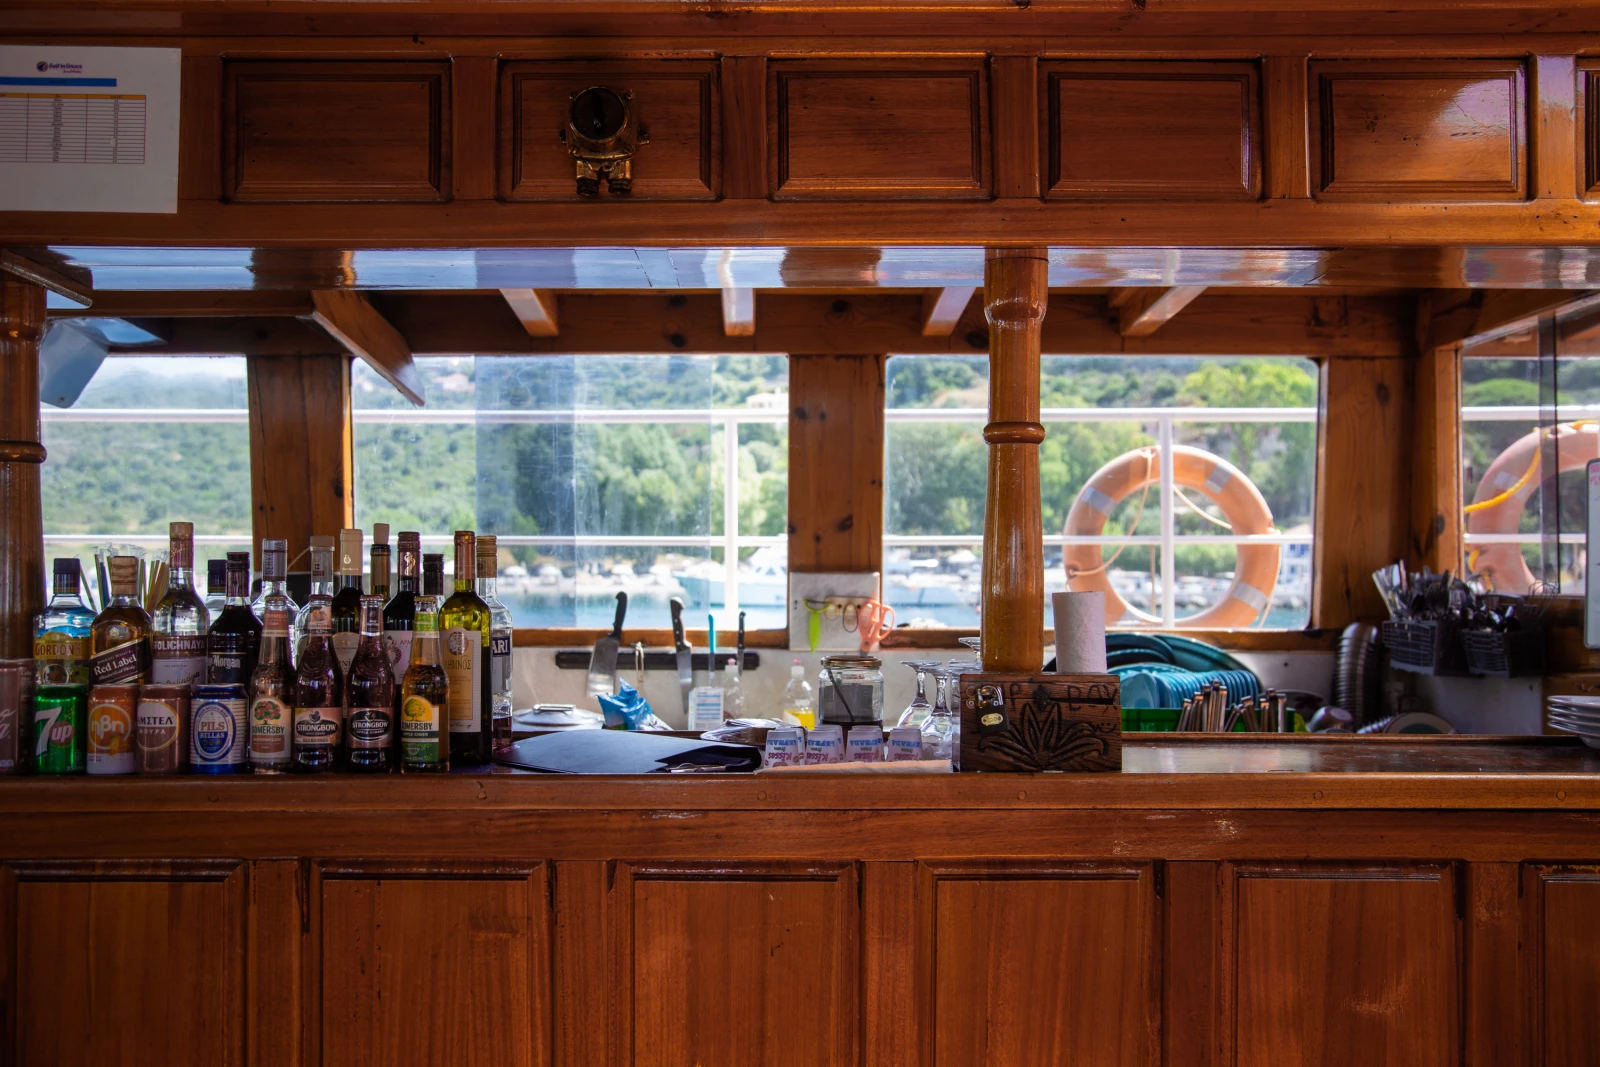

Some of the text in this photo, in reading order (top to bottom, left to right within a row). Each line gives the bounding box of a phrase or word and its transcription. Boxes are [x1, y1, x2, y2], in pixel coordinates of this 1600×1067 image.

[35, 643, 82, 656] GORDON'S
[93, 654, 137, 675] Red Label
[212, 655, 241, 670] Morgan
[200, 721, 225, 731] PILS
[251, 725, 285, 734] SOMERSBY
[297, 724, 337, 732] STRONGBOW
[767, 752, 792, 761] Kisses
